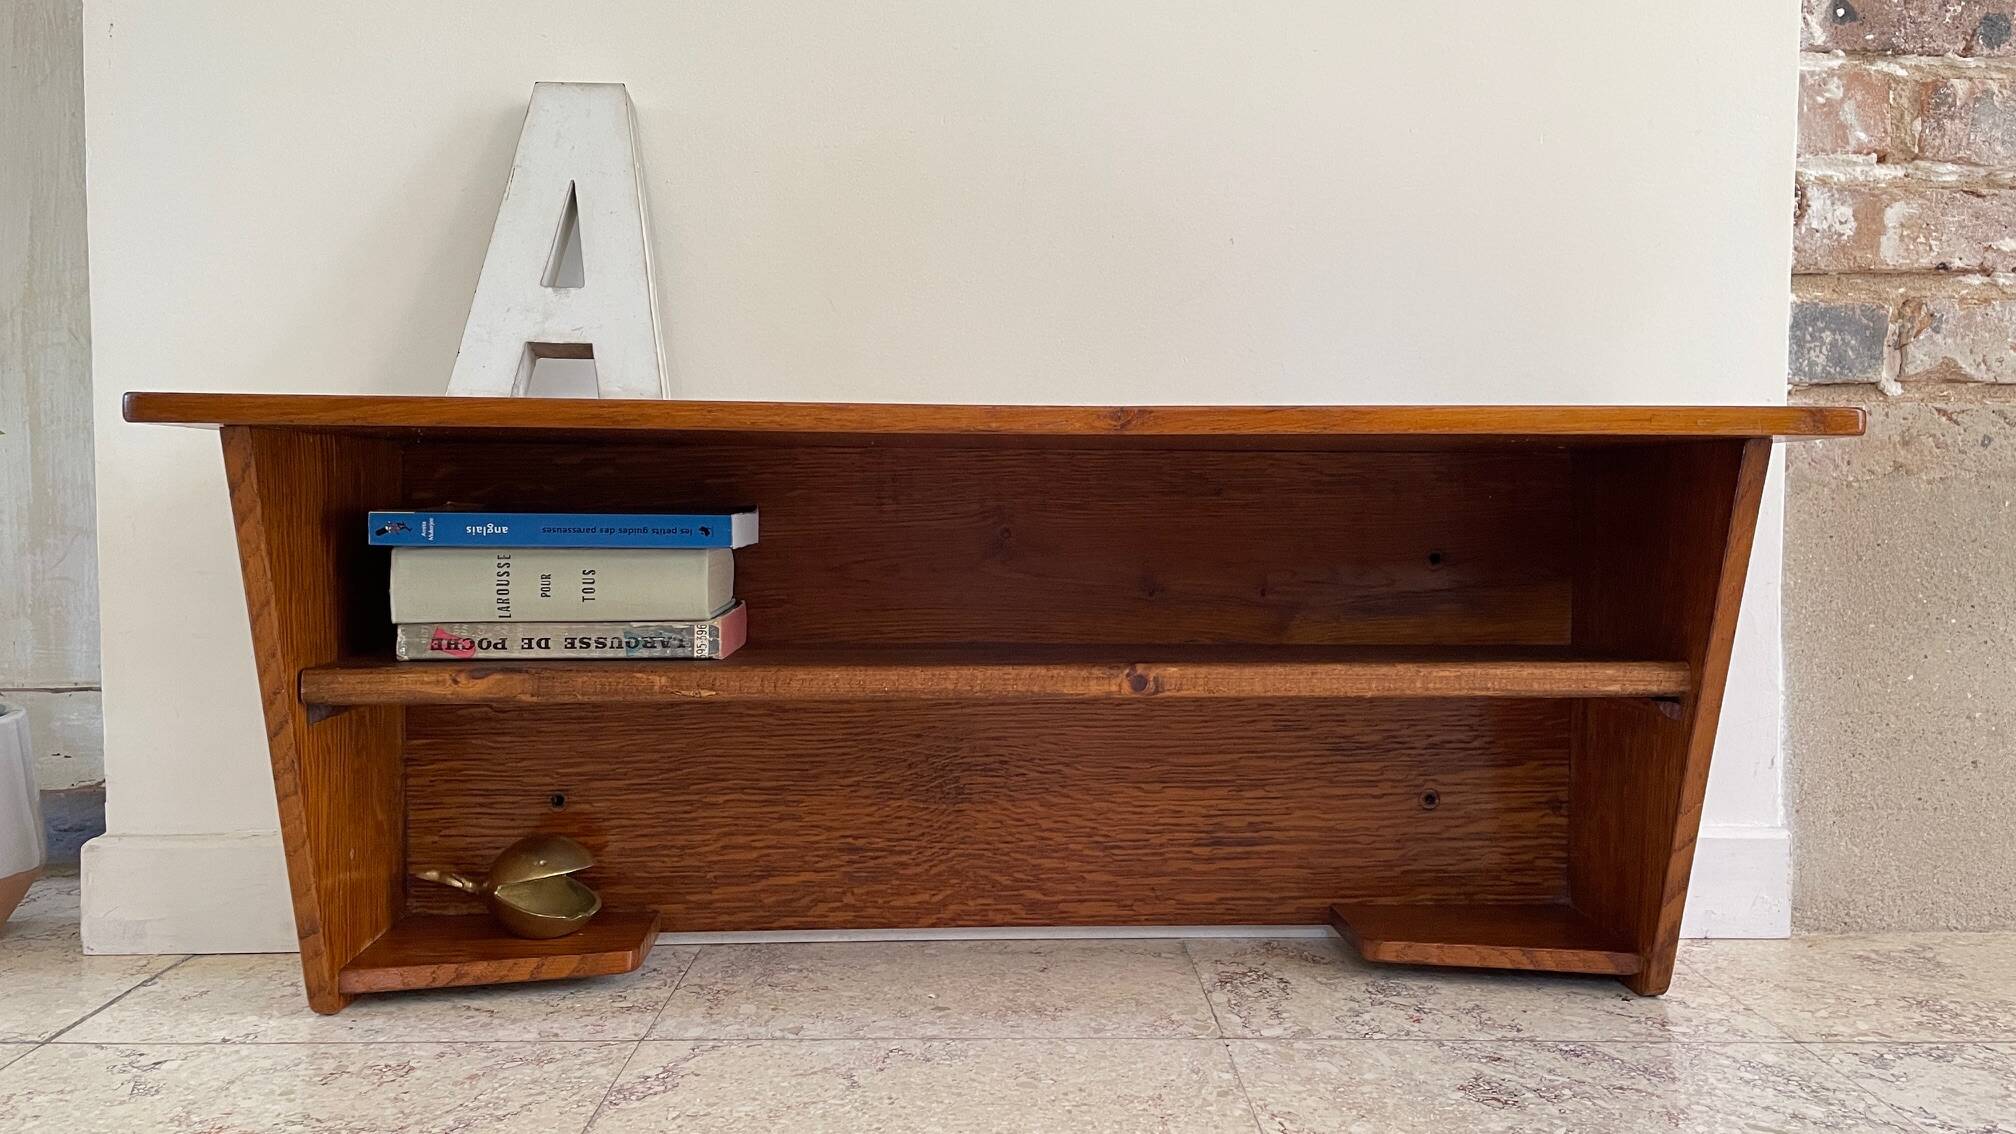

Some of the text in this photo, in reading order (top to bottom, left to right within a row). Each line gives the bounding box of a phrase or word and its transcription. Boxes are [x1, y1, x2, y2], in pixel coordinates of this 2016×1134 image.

[446, 82, 669, 399] A
[466, 523, 509, 536] anglais
[542, 526, 693, 536] les petits guides des paresseuses
[496, 554, 511, 619] LAROUSSE
[540, 573, 551, 598] POUR
[581, 569, 596, 602] TOUS
[430, 636, 692, 651] LAROUSSE DE POCHE
